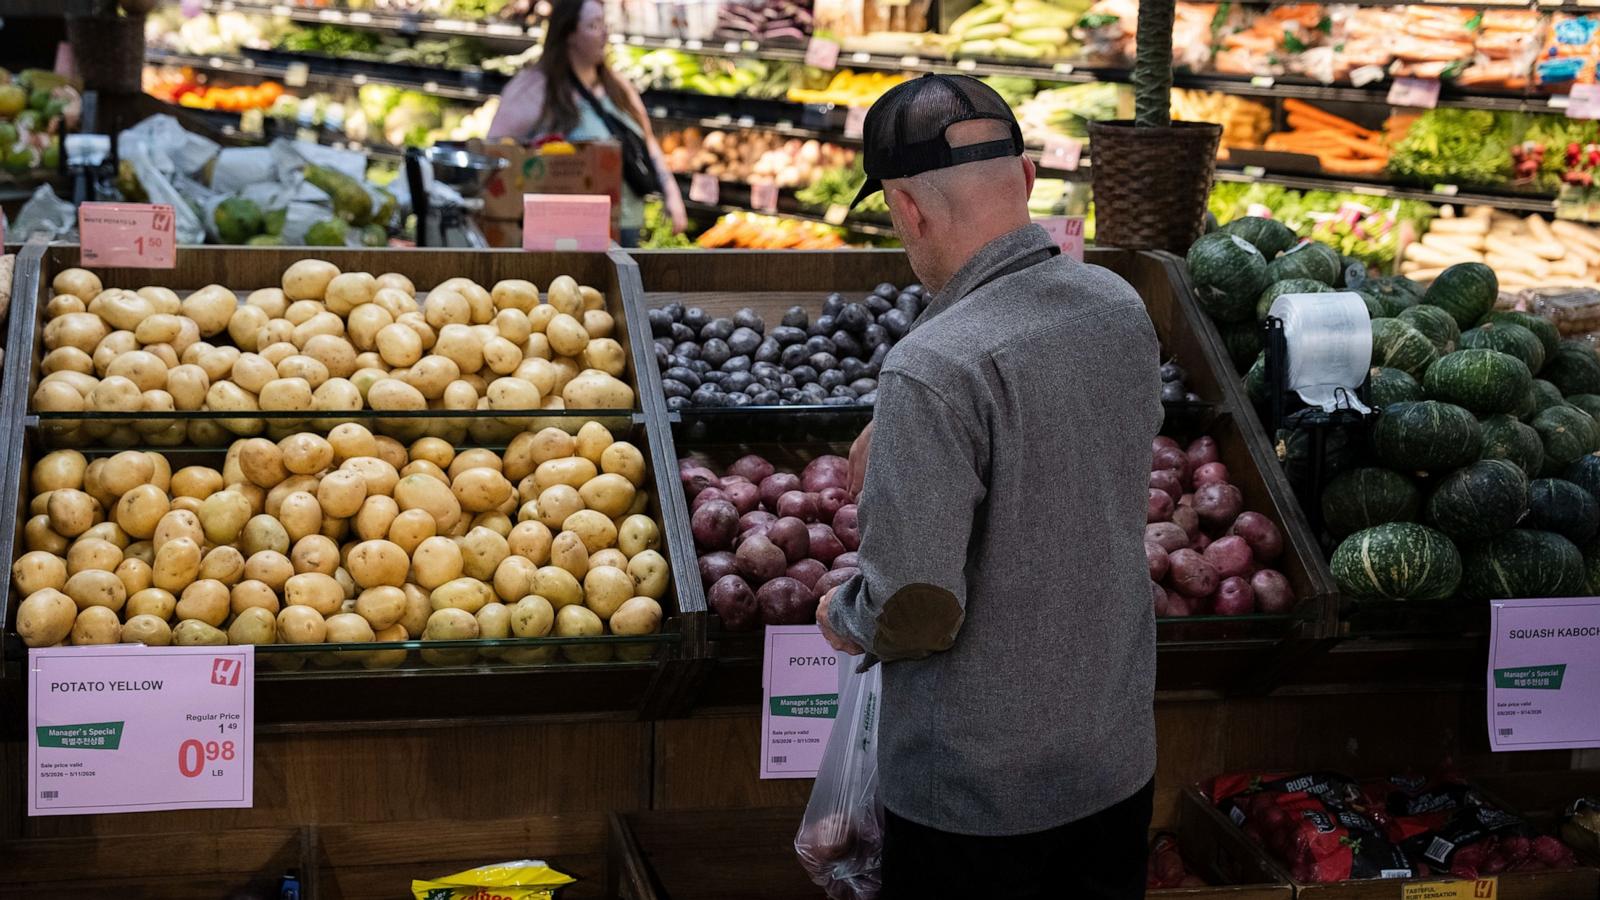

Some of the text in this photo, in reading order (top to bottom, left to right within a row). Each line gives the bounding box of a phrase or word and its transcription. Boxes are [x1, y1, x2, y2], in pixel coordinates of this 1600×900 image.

[134, 236, 162, 256] 1 50
[1509, 628, 1555, 639] SQUASH
[789, 656, 836, 666] POTATO
[1536, 669, 1559, 678] Special
[51, 680, 164, 693] POTATO YELLOW
[815, 698, 839, 706] Special
[186, 712, 240, 722] Regular Price
[88, 728, 116, 737] Special
[218, 723, 225, 734] 1
[212, 769, 224, 777] LB
[1285, 775, 1314, 793] RUBY
[1423, 890, 1457, 899] SENSATION
